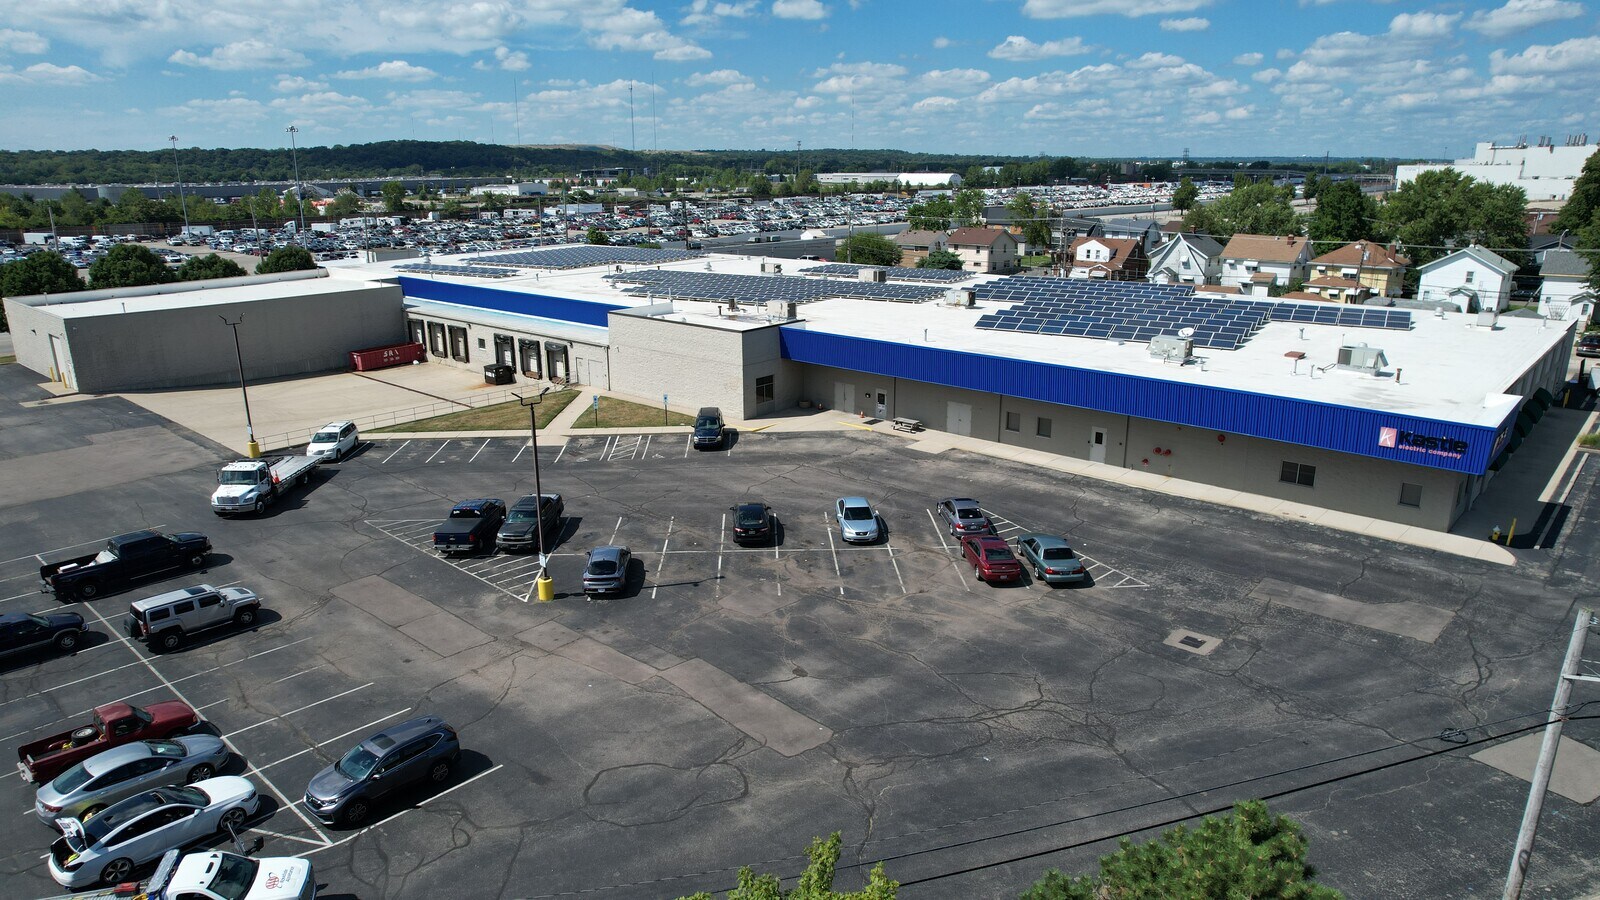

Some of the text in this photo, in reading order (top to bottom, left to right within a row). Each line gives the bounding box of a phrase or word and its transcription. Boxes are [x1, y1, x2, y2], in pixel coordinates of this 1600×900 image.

[1399, 431, 1468, 453] Kastle
[1399, 444, 1462, 460] electric company
